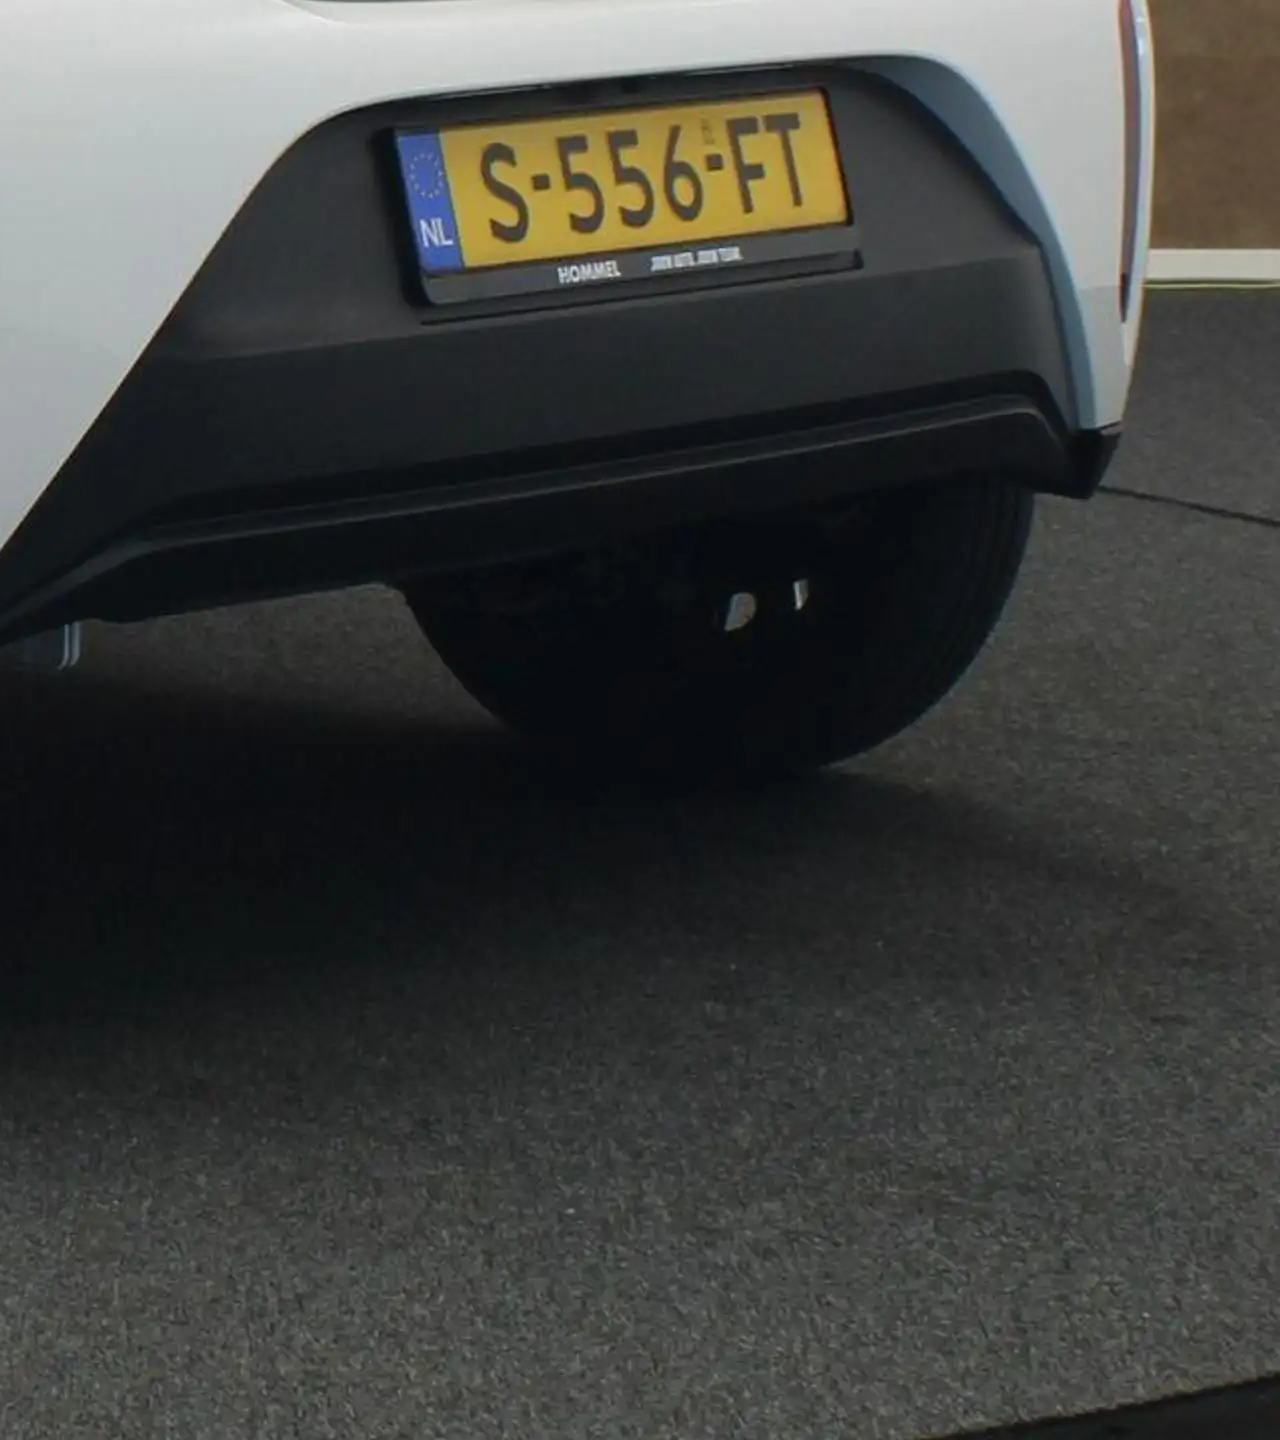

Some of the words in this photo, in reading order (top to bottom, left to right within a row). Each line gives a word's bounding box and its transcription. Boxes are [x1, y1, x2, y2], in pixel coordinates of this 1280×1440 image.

[419, 218, 454, 248] NL
[480, 112, 803, 244] S-556-FT
[557, 260, 622, 285] HOMMEL
